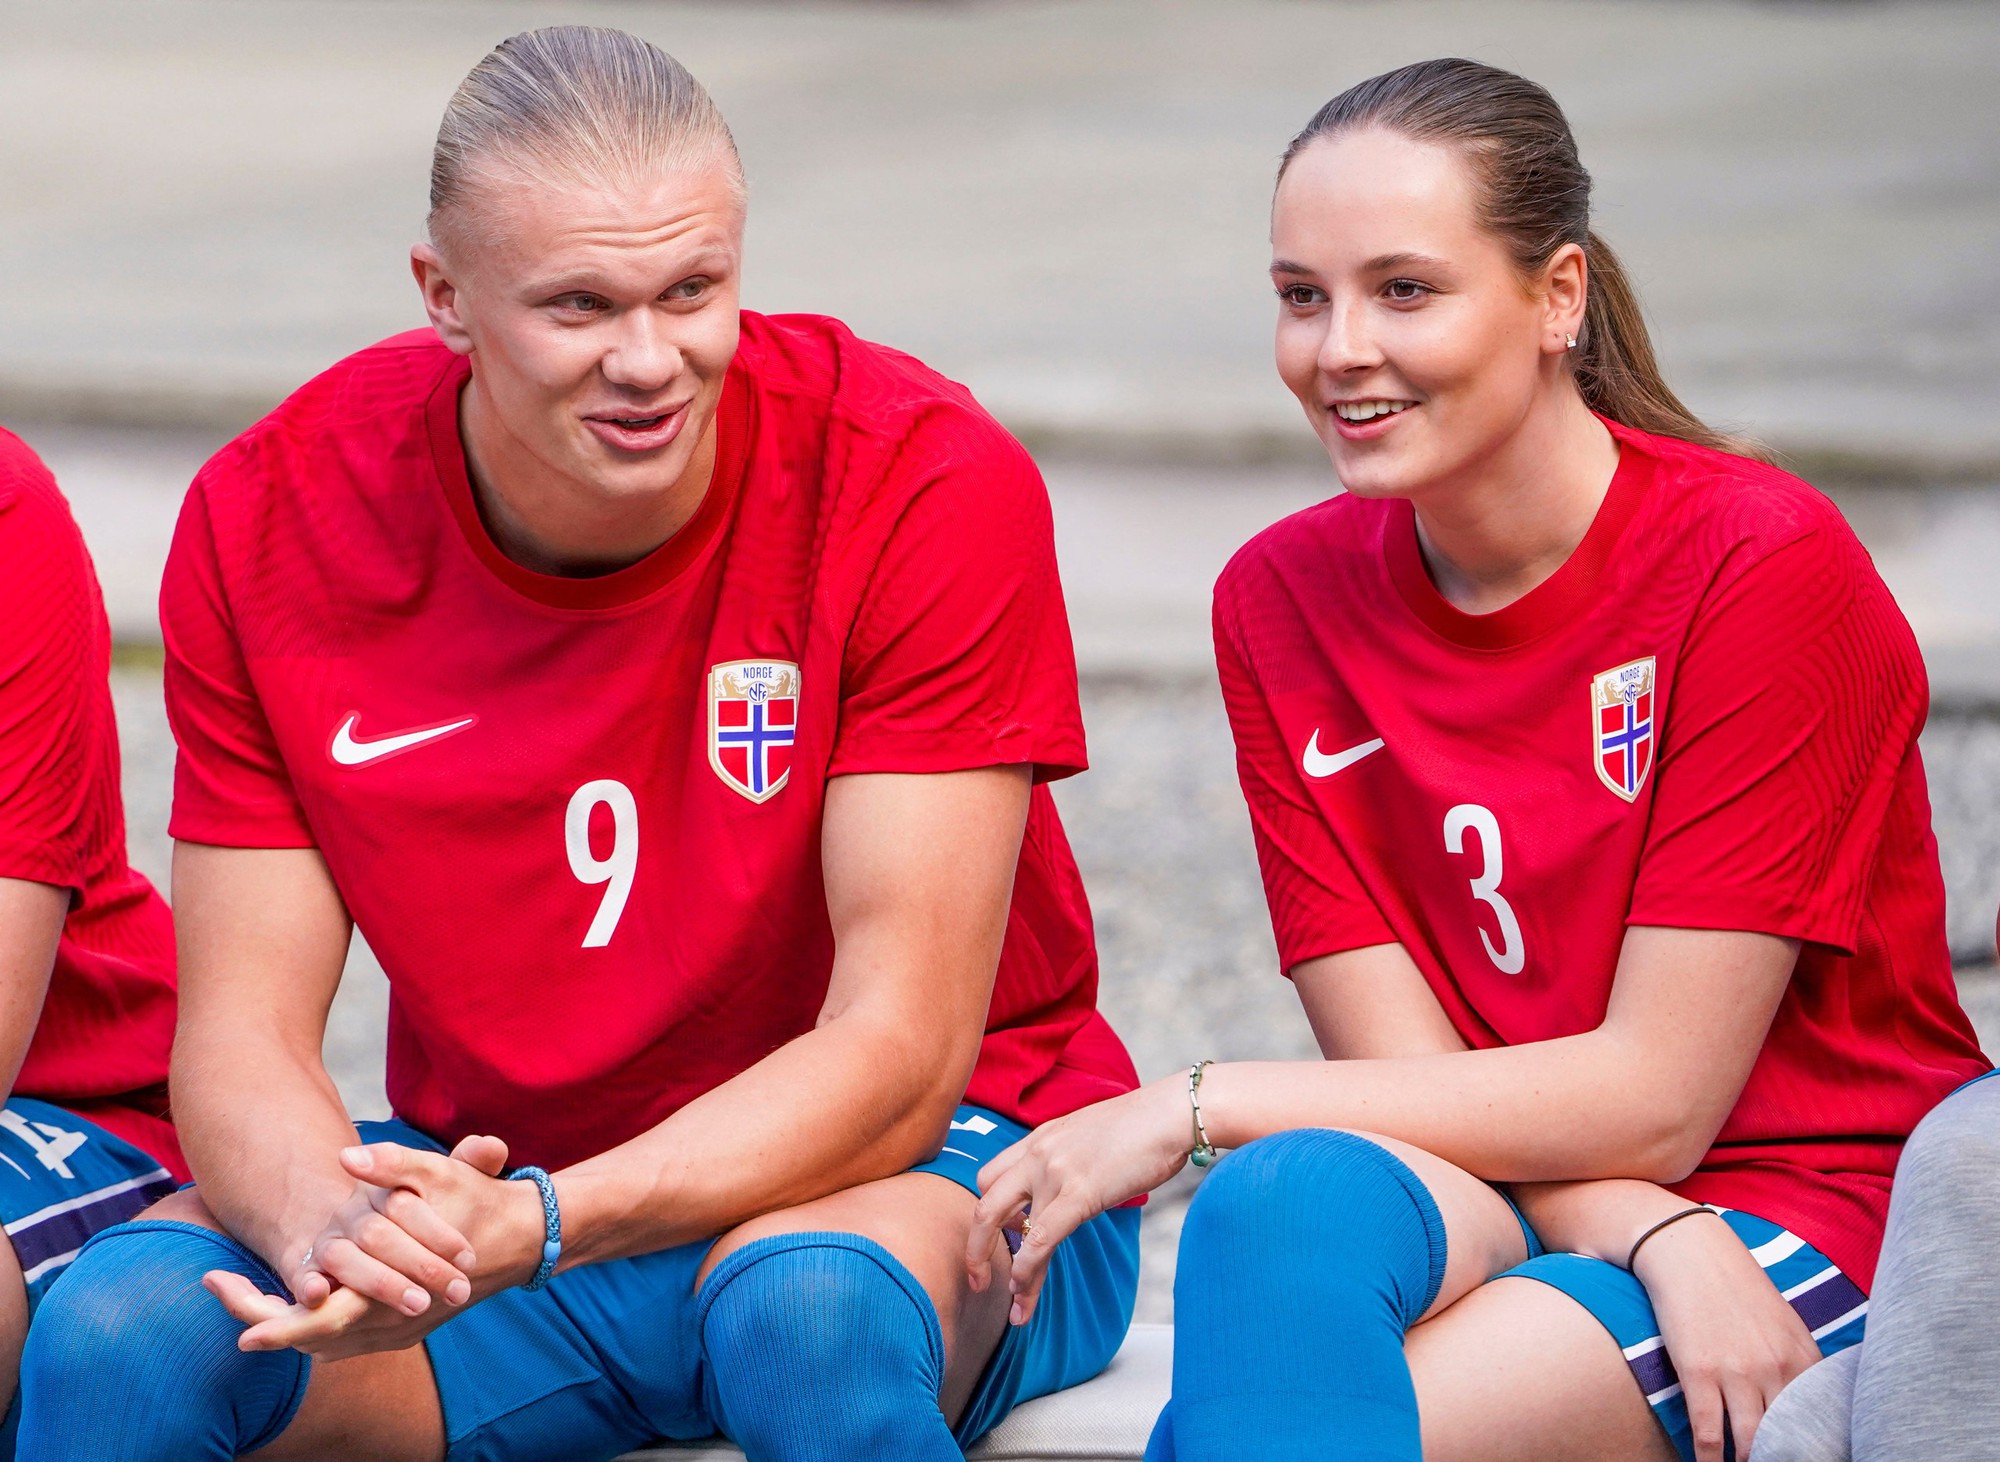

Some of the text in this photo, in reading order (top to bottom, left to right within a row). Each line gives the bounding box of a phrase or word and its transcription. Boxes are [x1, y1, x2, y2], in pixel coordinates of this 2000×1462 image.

[743, 666, 773, 679] NORGE
[1620, 666, 1640, 682] NORGE
[565, 780, 638, 947] 9
[1444, 804, 1524, 974] 3
